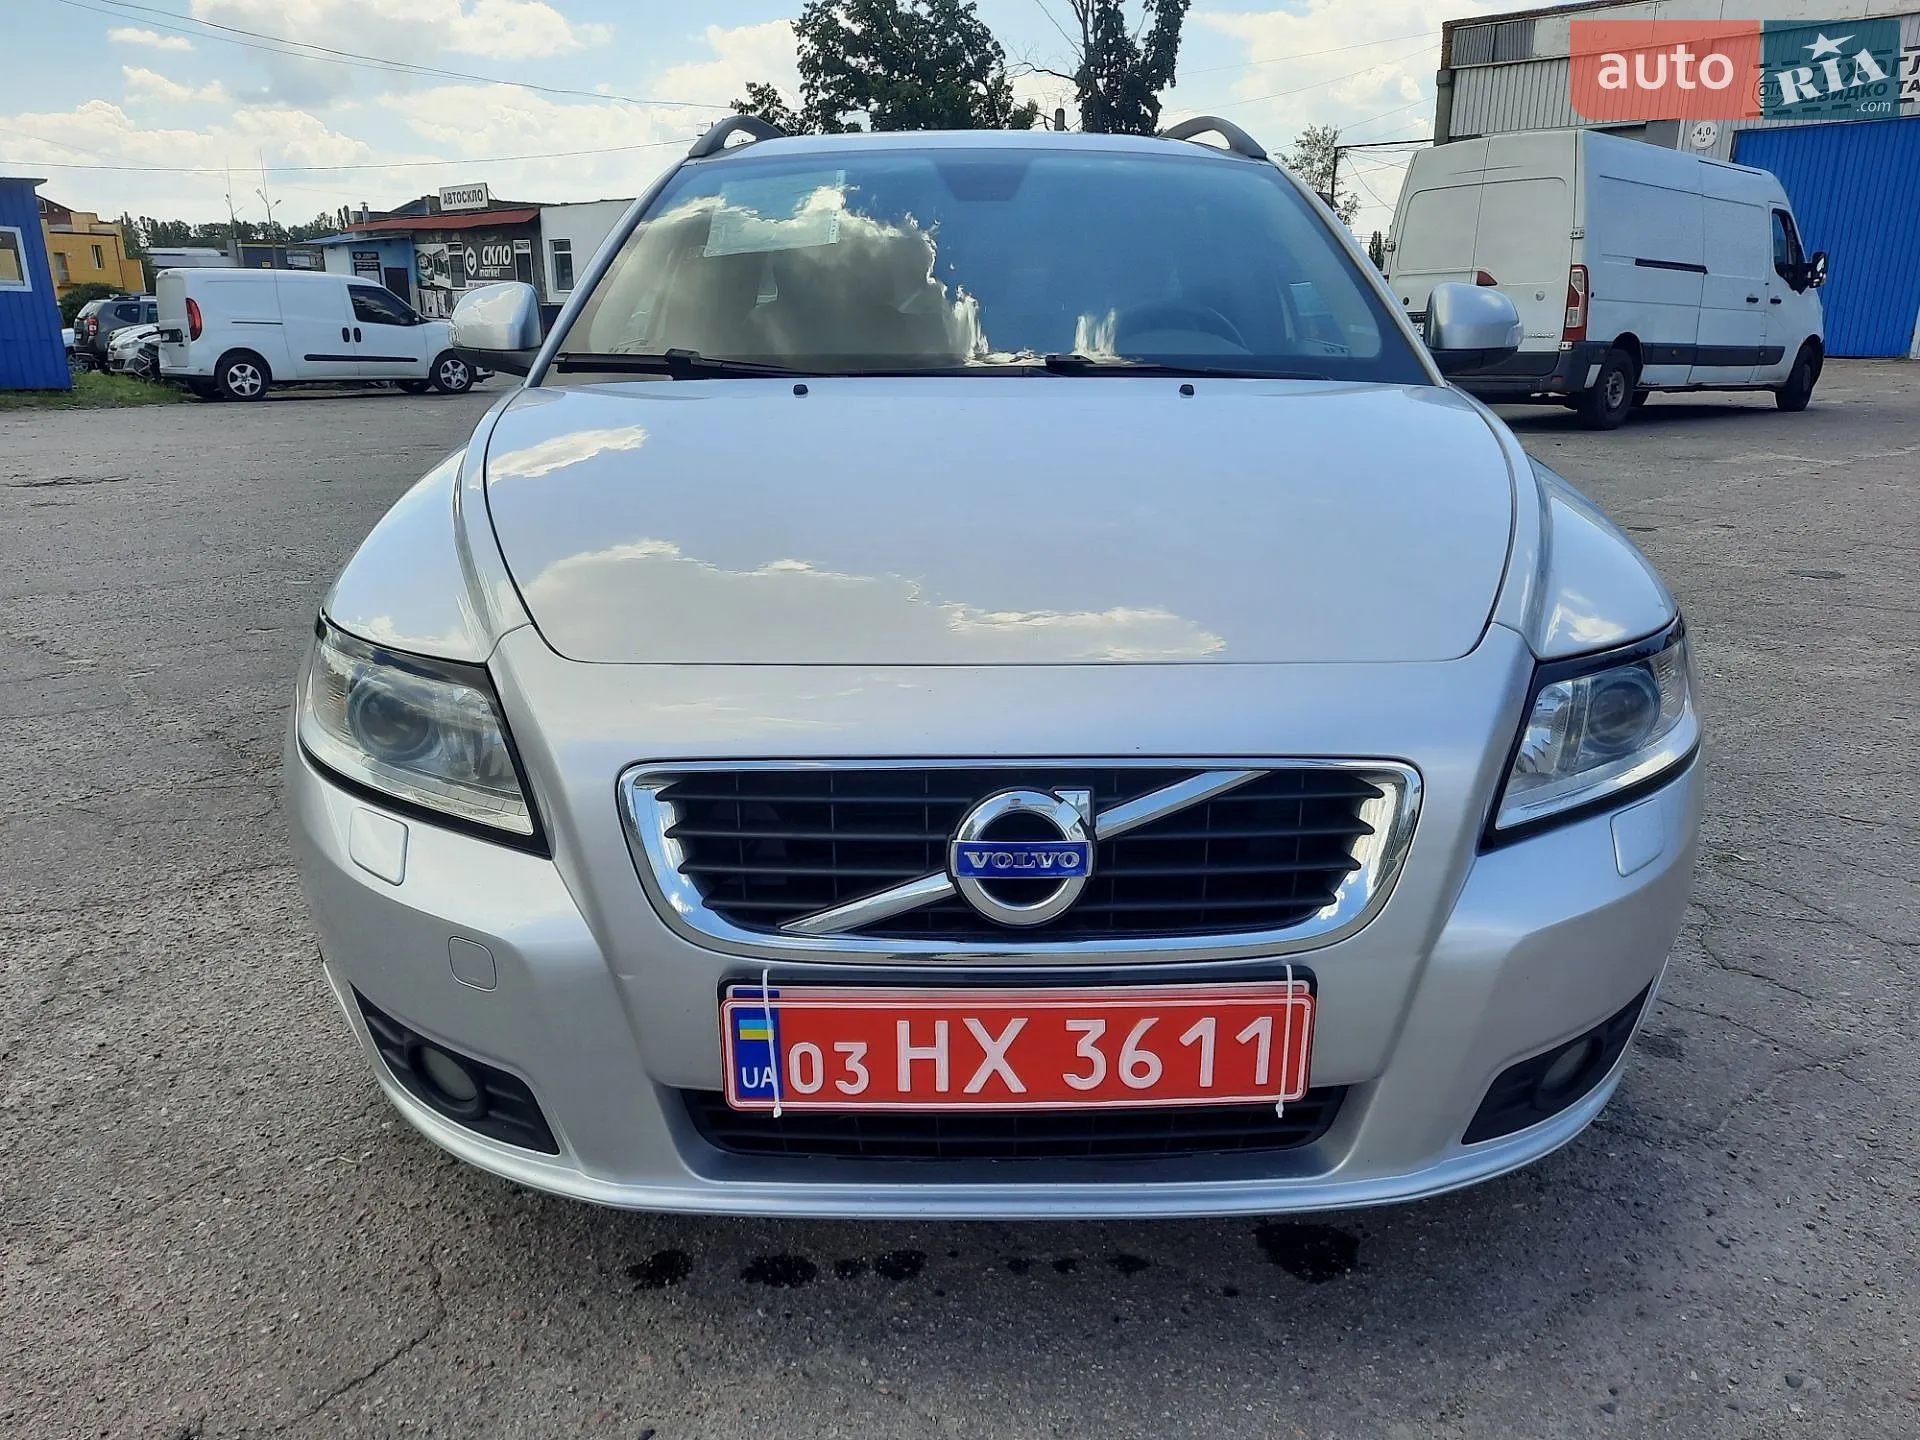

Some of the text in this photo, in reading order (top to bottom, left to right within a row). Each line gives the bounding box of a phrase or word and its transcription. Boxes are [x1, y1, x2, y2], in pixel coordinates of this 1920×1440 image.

[443, 188, 483, 205] АВТОСКЛО
[482, 245, 511, 265] СКЛО
[479, 268, 501, 277] market
[964, 851, 1080, 869] VOLVO
[788, 1016, 1273, 1095] 03 HX 3611
[742, 1066, 775, 1089] UA
